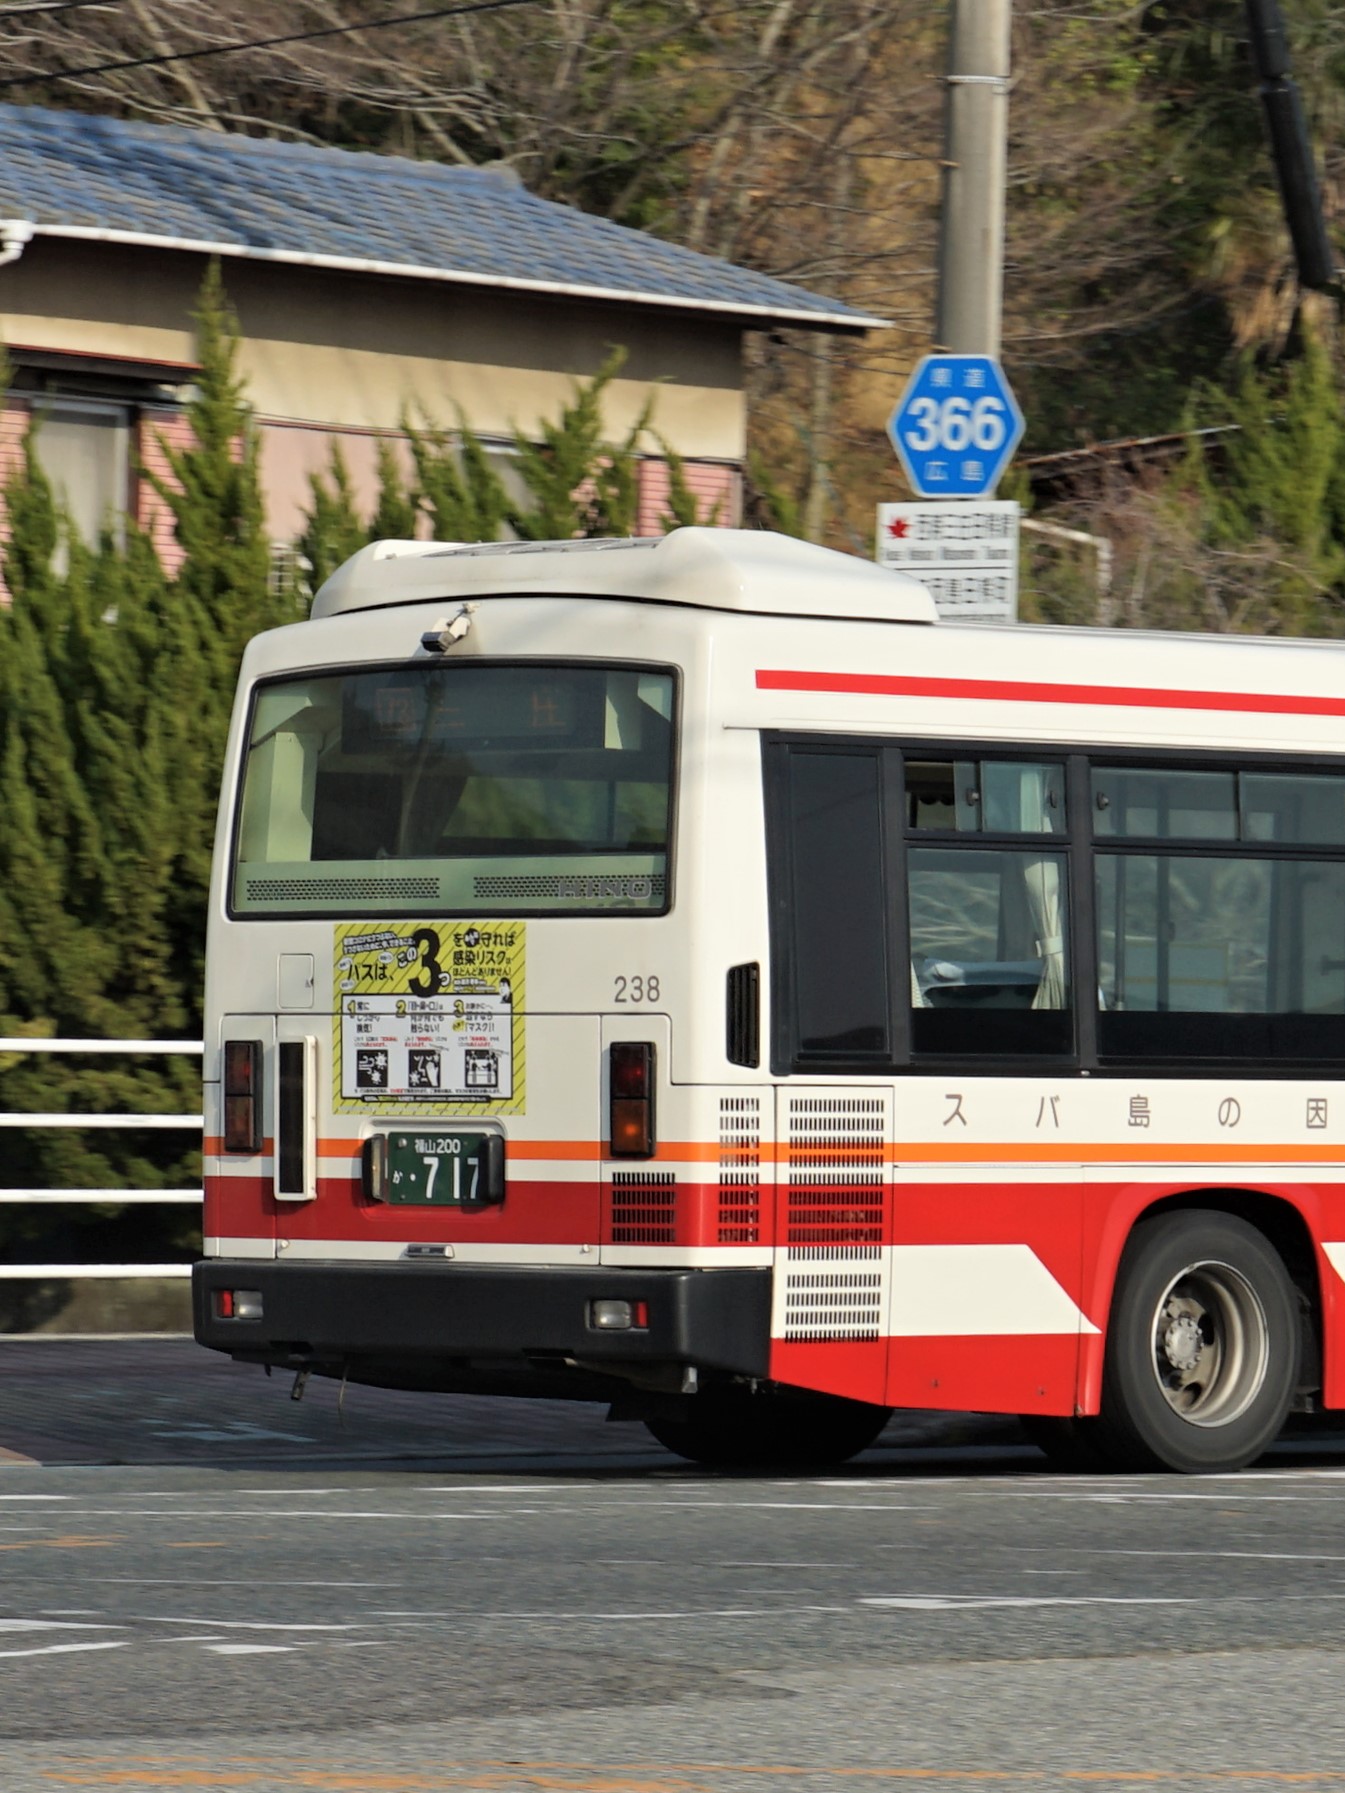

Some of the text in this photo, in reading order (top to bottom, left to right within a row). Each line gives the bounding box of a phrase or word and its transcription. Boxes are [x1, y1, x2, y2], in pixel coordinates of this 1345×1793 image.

[904, 396, 1006, 451] 366
[559, 879, 652, 899] HINO
[408, 928, 442, 997] 3
[614, 975, 661, 1003] 238
